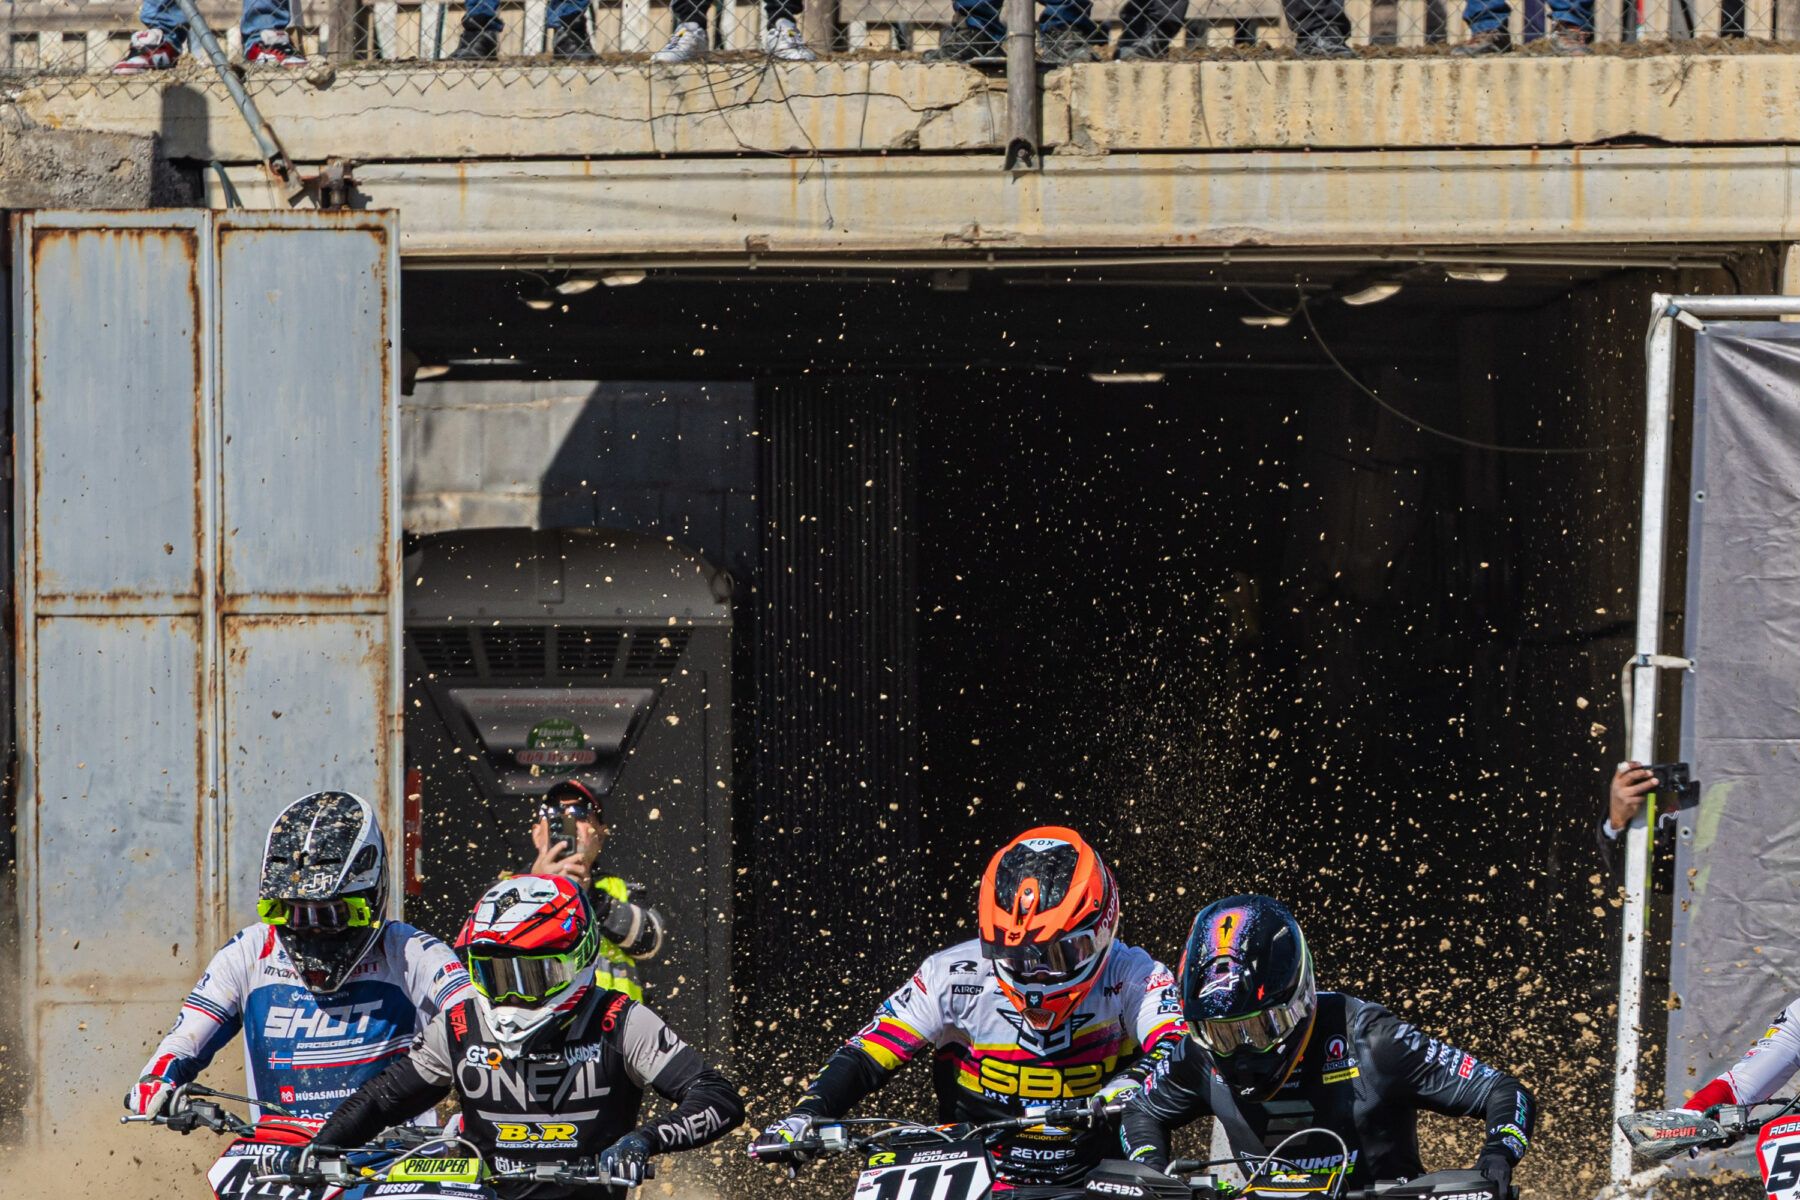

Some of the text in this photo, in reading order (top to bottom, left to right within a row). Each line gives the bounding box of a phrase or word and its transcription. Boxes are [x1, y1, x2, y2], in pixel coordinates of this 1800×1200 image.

[1028, 838, 1055, 847] FOX
[264, 1000, 383, 1038] SHOT
[296, 1037, 364, 1049] RACEGEAR
[980, 1056, 1103, 1098] SB2
[296, 1087, 360, 1101] HÚSASMIDJA
[984, 1088, 1010, 1105] MX
[1655, 1126, 1697, 1140] CIRCUIT
[911, 1151, 968, 1164] BODEGA
[913, 1149, 943, 1158] LUCAS
[1010, 1146, 1076, 1160] REYDES
[407, 1159, 468, 1174] PROTAPER
[375, 1183, 425, 1195] BUSSOT
[1086, 1180, 1144, 1197] ACERBIS
